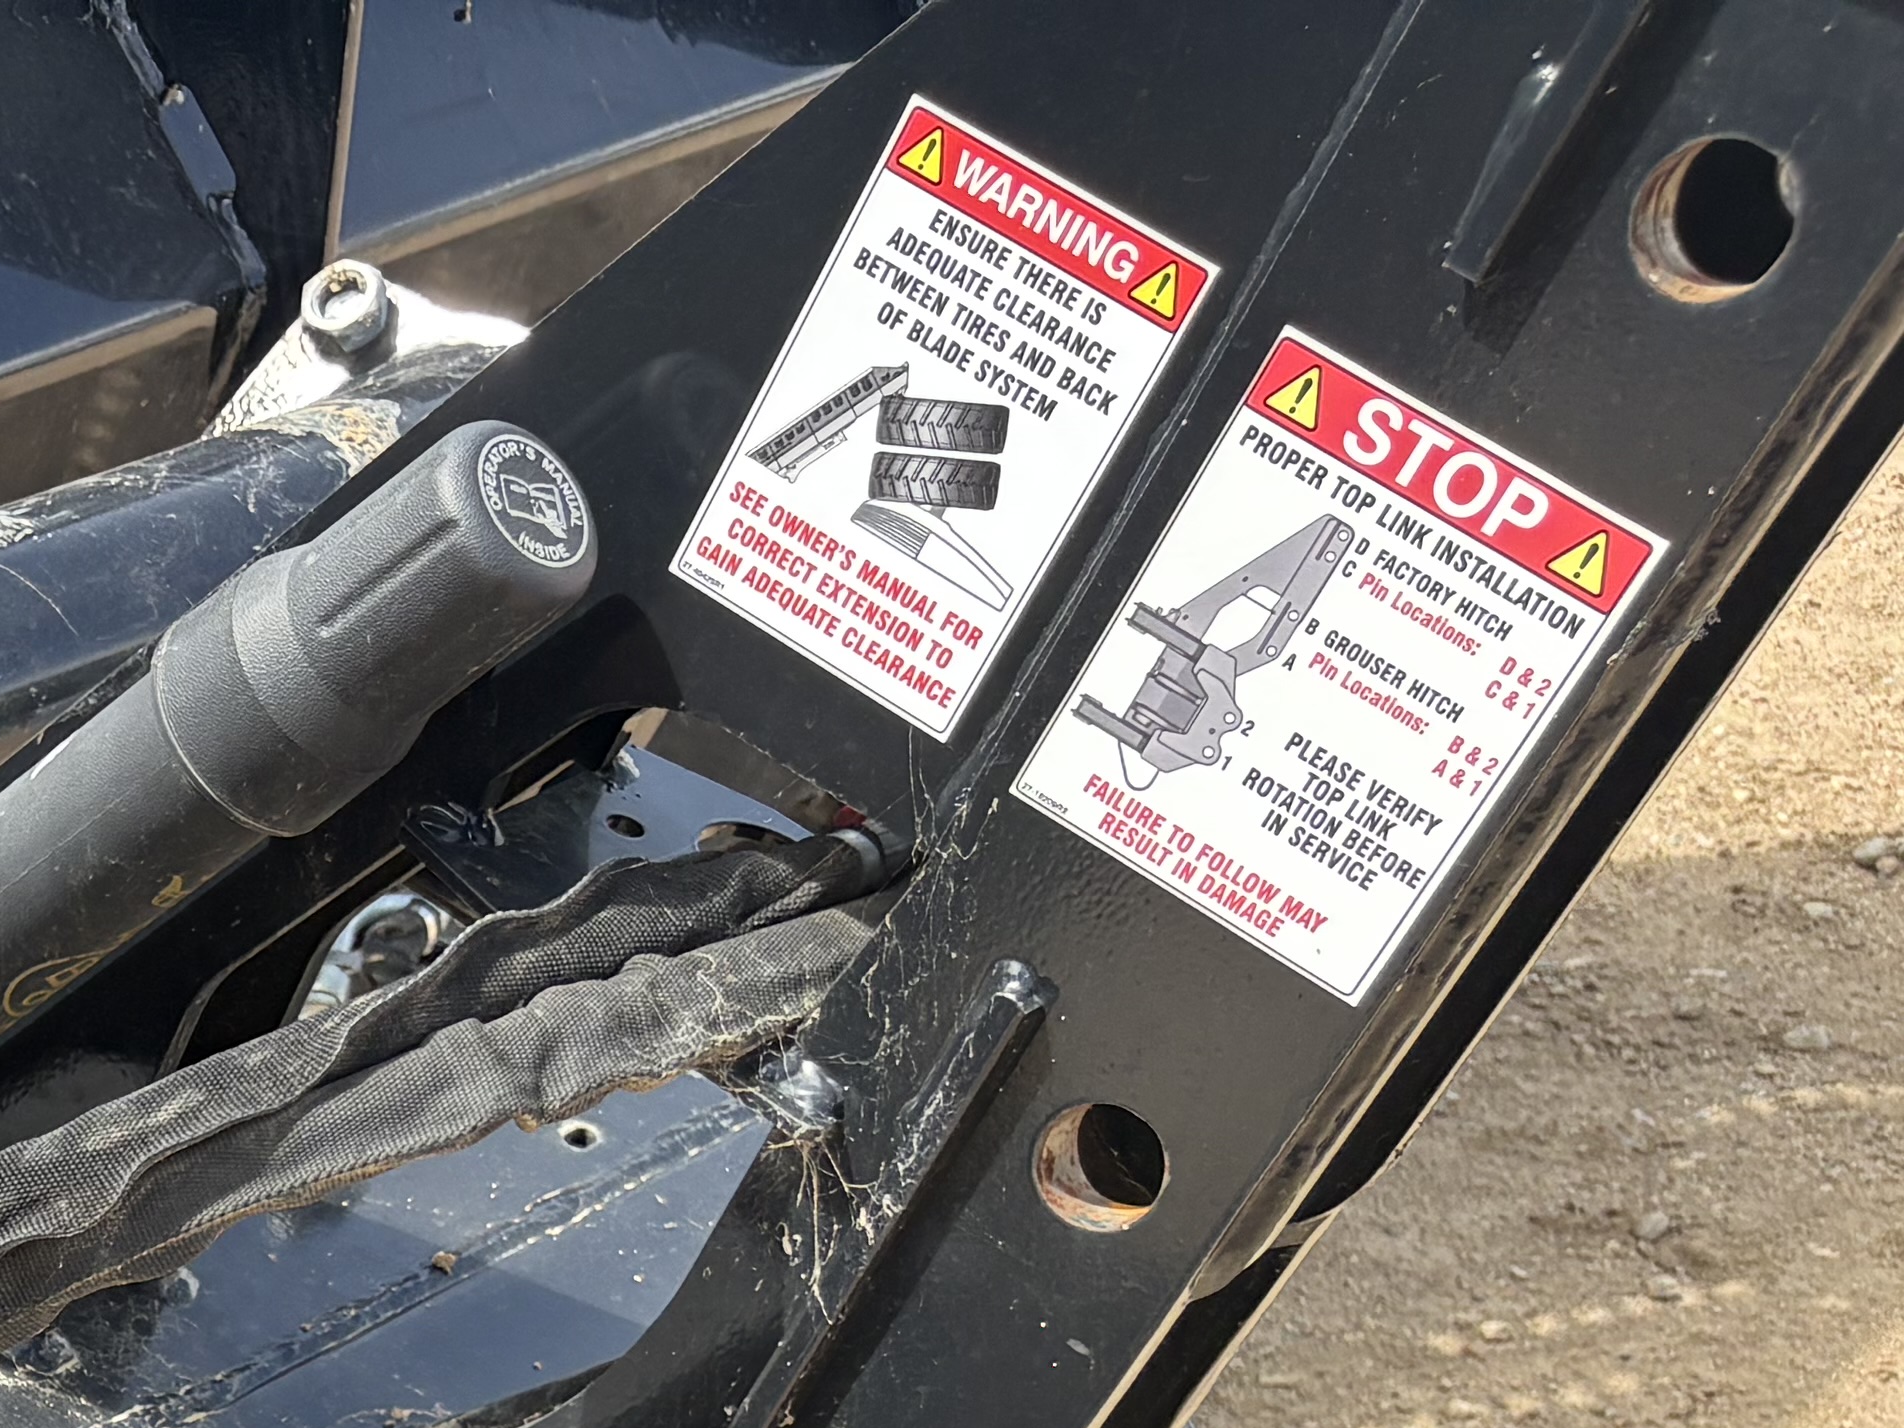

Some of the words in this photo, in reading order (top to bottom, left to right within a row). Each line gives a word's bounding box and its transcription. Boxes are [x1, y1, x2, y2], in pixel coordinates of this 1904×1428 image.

[928, 208, 1013, 271] ENSURE
[1013, 255, 1083, 312] THERE
[1080, 297, 1107, 326] IS
[953, 149, 1139, 284] WARNING
[853, 246, 950, 318] BETWEEN
[950, 302, 1011, 353] TIRES
[1009, 340, 1057, 379] AND
[1056, 366, 1119, 416] BACK
[885, 226, 994, 301] ADEQUATE
[992, 287, 1117, 374] CLEARANCE
[877, 301, 909, 330] OF
[906, 318, 975, 373] BLADE
[974, 359, 1059, 422] SYSTEM
[541, 458, 582, 528] MANUAL
[1343, 398, 1550, 537] STOP
[518, 530, 571, 561] INSIDE
[729, 481, 769, 517] SEE
[856, 559, 938, 624] MANUAL
[939, 610, 984, 650] FOR
[1239, 424, 1329, 491] PROPER
[1330, 475, 1377, 514] TOP
[1375, 503, 1434, 550] LINK
[1430, 535, 1586, 640] INSTALLATION
[1341, 559, 1357, 578] C
[1354, 537, 1371, 556] D
[696, 535, 744, 577] GAIN
[741, 565, 842, 638] ADEQUATE
[841, 626, 957, 709] CLEARANCE
[727, 517, 818, 584] CORRECT
[815, 572, 925, 652] EXTENSION
[925, 639, 954, 669] TO
[1304, 617, 1320, 636] B
[1358, 572, 1389, 602] Pin
[1390, 591, 1482, 656] Locations:
[1499, 656, 1518, 676] D
[1517, 667, 1535, 688] &
[1534, 678, 1552, 697] 2
[1372, 548, 1457, 606] FACTORY
[1454, 596, 1514, 642] HITCH
[1281, 653, 1297, 672] A
[1308, 651, 1339, 681] Pin
[1339, 670, 1430, 735] Locations:
[1447, 735, 1465, 755] B
[1464, 746, 1482, 767] &
[1481, 757, 1499, 776] 2
[1324, 629, 1407, 690] GROUSER
[1406, 678, 1465, 724] HITCH
[1484, 679, 1503, 699] C
[1501, 690, 1520, 712] &
[1522, 702, 1536, 720] 1
[1221, 755, 1233, 771] 1
[1240, 719, 1256, 737] 2
[1283, 731, 1366, 792] PLEASE
[1366, 779, 1443, 836] VERIFY
[1431, 759, 1449, 778] A
[1449, 768, 1466, 789] &
[1469, 780, 1483, 797] 1
[1083, 773, 1167, 836] FAILURE
[1167, 824, 1196, 854] TO
[1194, 843, 1282, 905] FOLLOW
[1278, 895, 1329, 934] MAY
[1241, 767, 1343, 839] ROTATION
[1341, 828, 1427, 890] BEFORE
[1260, 808, 1289, 837] IN
[1287, 825, 1379, 891] SERVICE
[1302, 771, 1345, 807] TOP
[1344, 798, 1398, 842] LINK
[1097, 811, 1174, 867] RESULT
[1170, 857, 1198, 884] IN
[1196, 873, 1285, 938] DAMAGE
